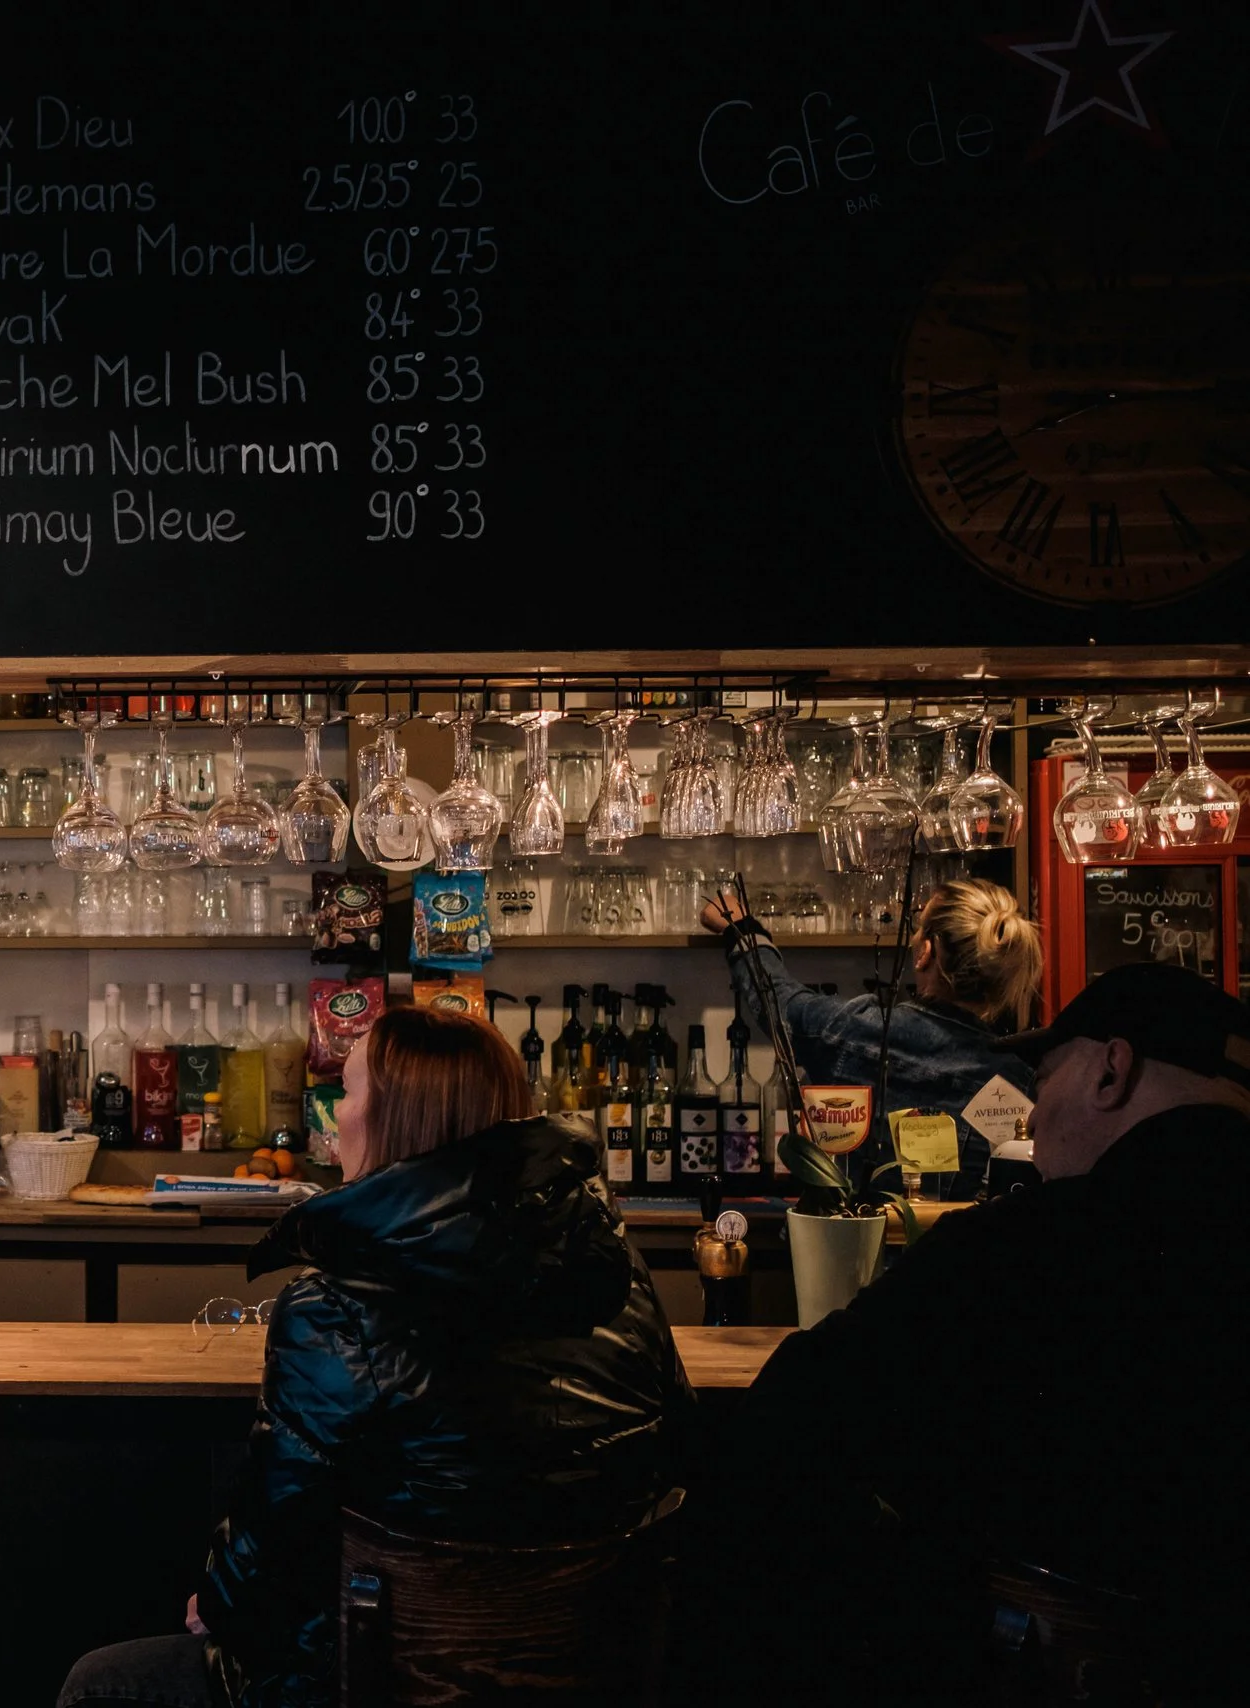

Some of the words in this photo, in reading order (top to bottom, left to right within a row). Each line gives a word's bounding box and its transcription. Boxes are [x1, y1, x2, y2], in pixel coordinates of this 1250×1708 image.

[36, 95, 133, 149] Dieu
[435, 95, 478, 142] 33
[698, 91, 877, 204] Café
[906, 81, 994, 166] de
[437, 161, 483, 208] 25
[844, 192, 883, 216] BAR
[62, 228, 114, 281] La
[136, 222, 316, 277] Mordue
[430, 225, 499, 275] 275
[434, 288, 483, 338] 33
[92, 350, 172, 408] Mel
[196, 349, 307, 406] Bush
[435, 355, 486, 403] 33
[110, 421, 338, 476] Nocturnum
[433, 422, 487, 472] 33
[112, 489, 247, 545] Bleue
[439, 489, 486, 540] 33
[1096, 883, 1215, 908] Saucissons
[808, 1104, 867, 1127] Campus
[973, 1106, 1027, 1119] AVERBODE
